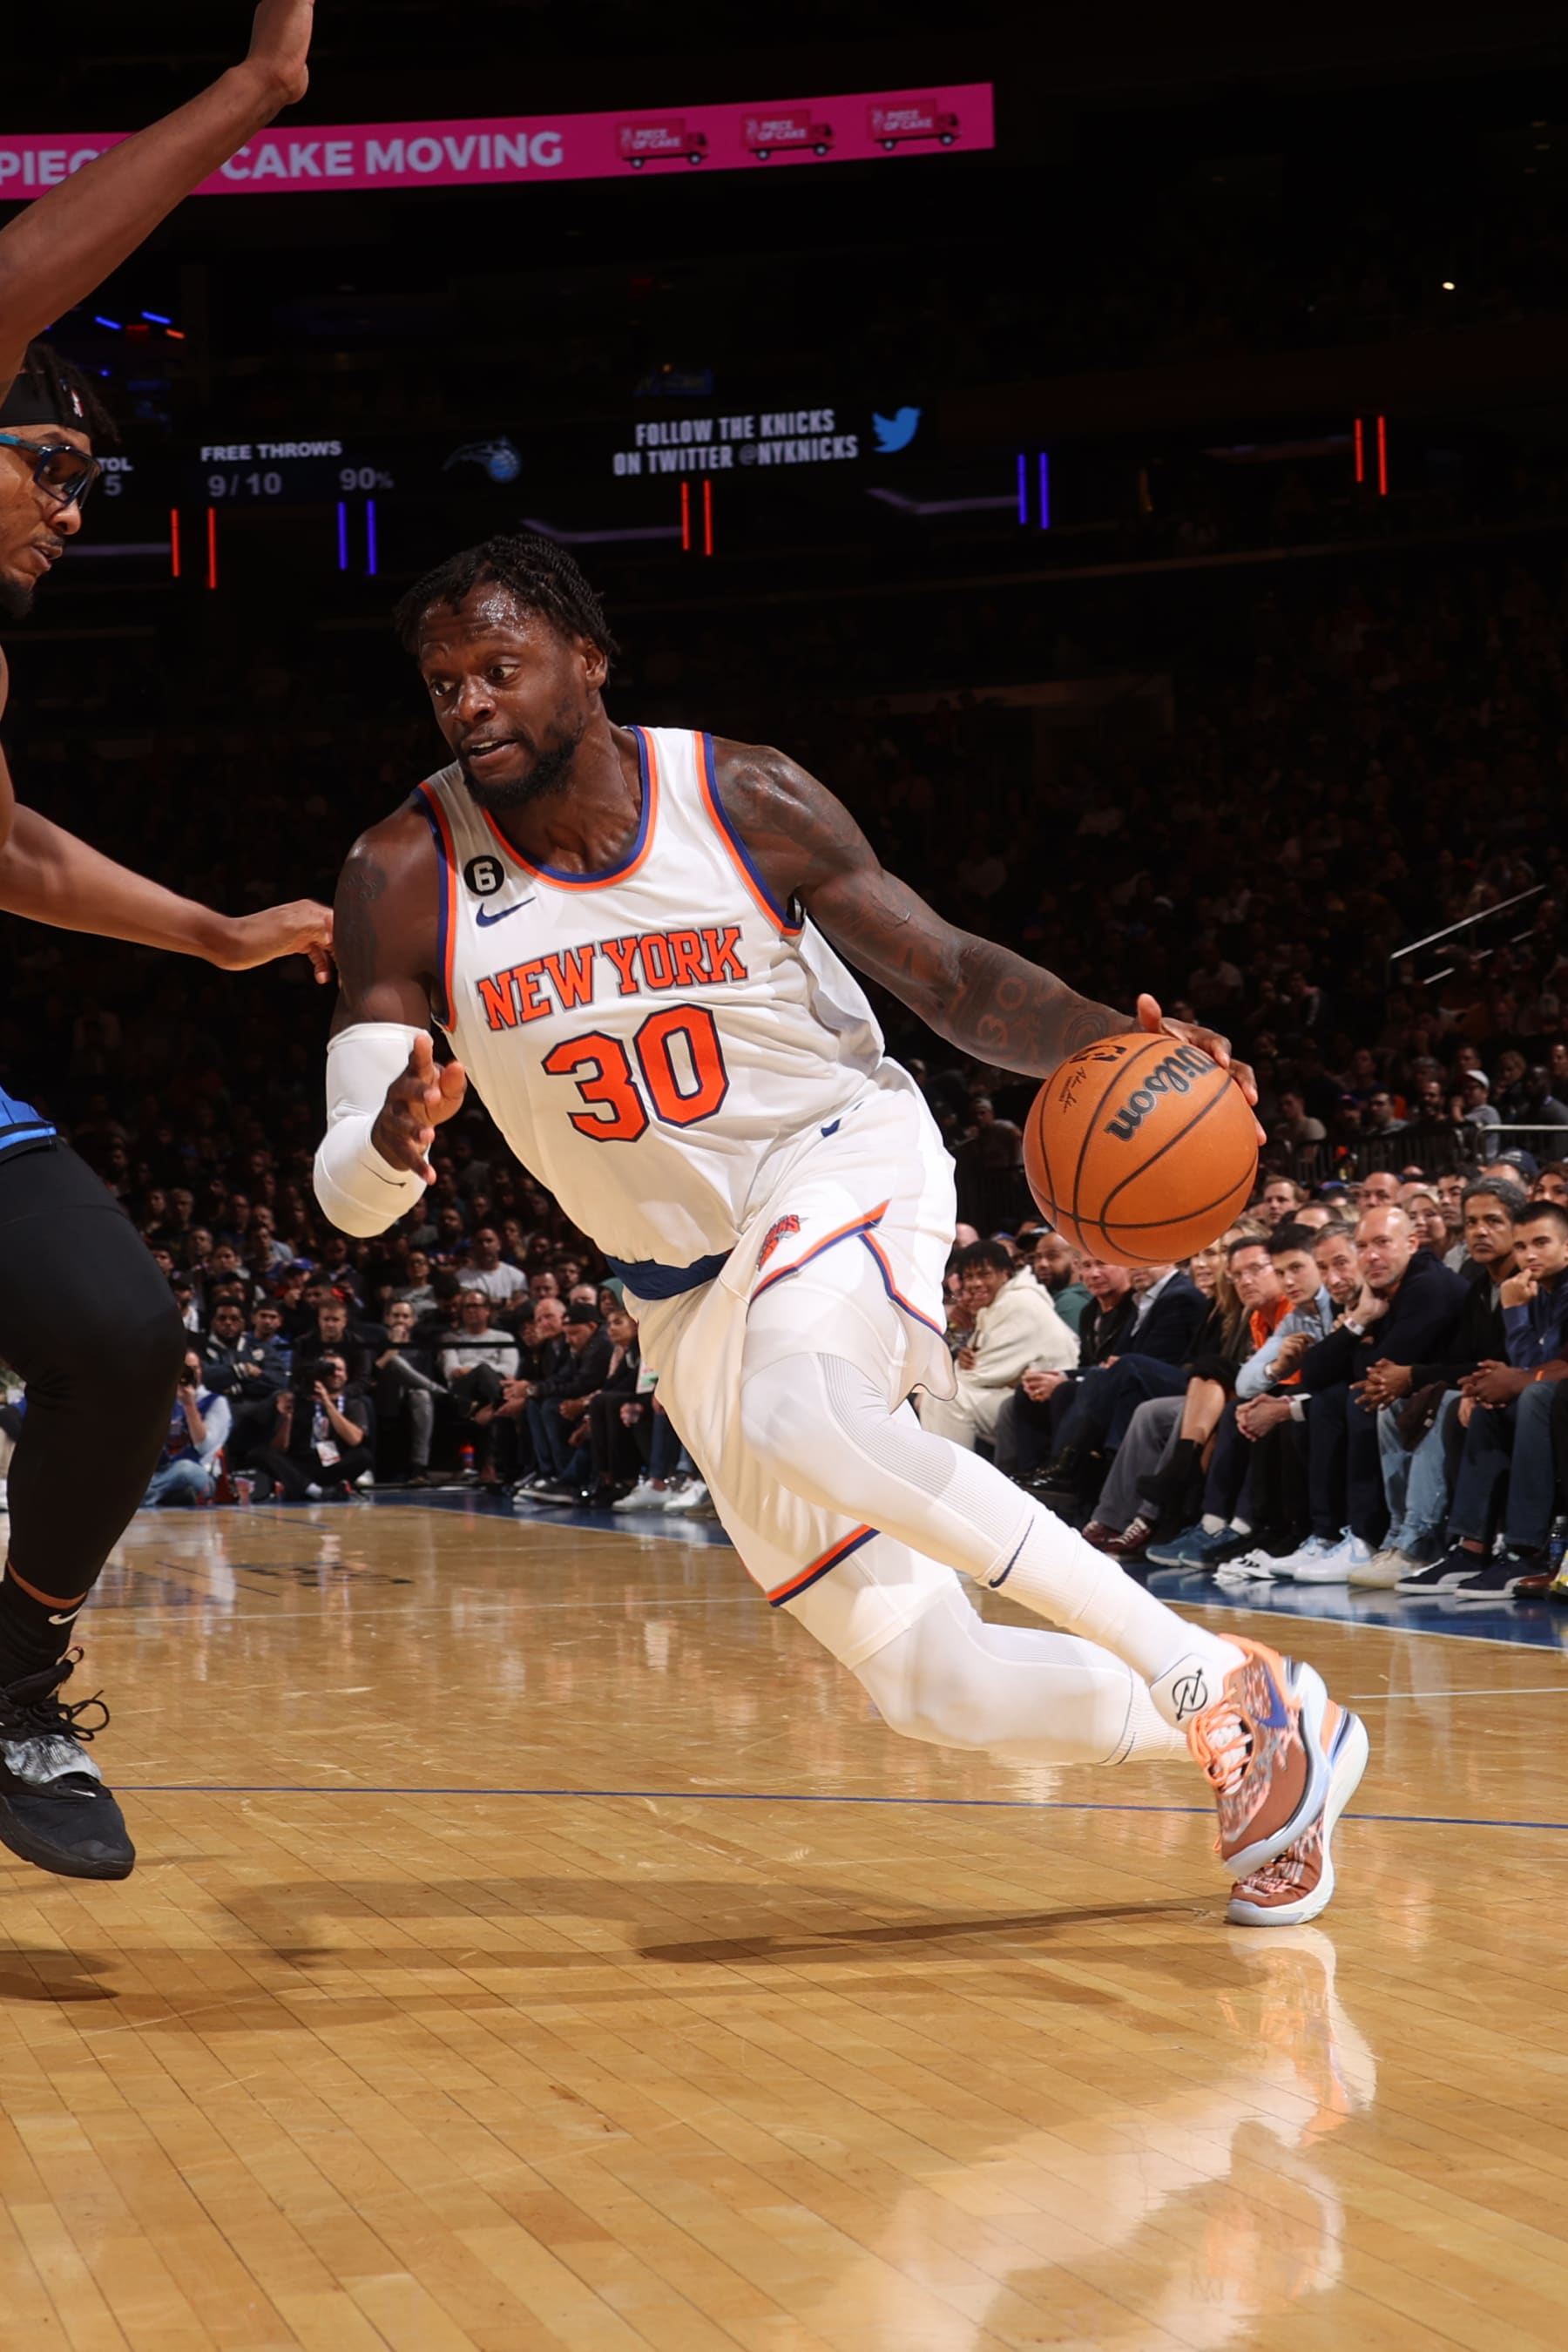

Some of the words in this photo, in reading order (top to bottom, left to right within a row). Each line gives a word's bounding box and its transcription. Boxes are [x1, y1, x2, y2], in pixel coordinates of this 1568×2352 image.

[220, 140, 355, 180] CAKE
[366, 131, 564, 174] MOVING
[636, 419, 713, 447] FOLLOW
[718, 416, 755, 440] THE
[760, 409, 835, 437] KNICKS
[199, 444, 253, 463] FREE
[255, 439, 343, 460] THROWS
[613, 452, 641, 476] ON
[647, 445, 733, 473] TWITTER
[739, 436, 858, 465] @NYKNICKS
[103, 474, 123, 497] 5
[339, 466, 395, 492] 90%
[473, 861, 496, 892] 6
[476, 943, 597, 1031] NEW
[598, 926, 748, 997] YORK
[541, 1003, 730, 1142] 30
[1104, 1044, 1218, 1142] Wilson
